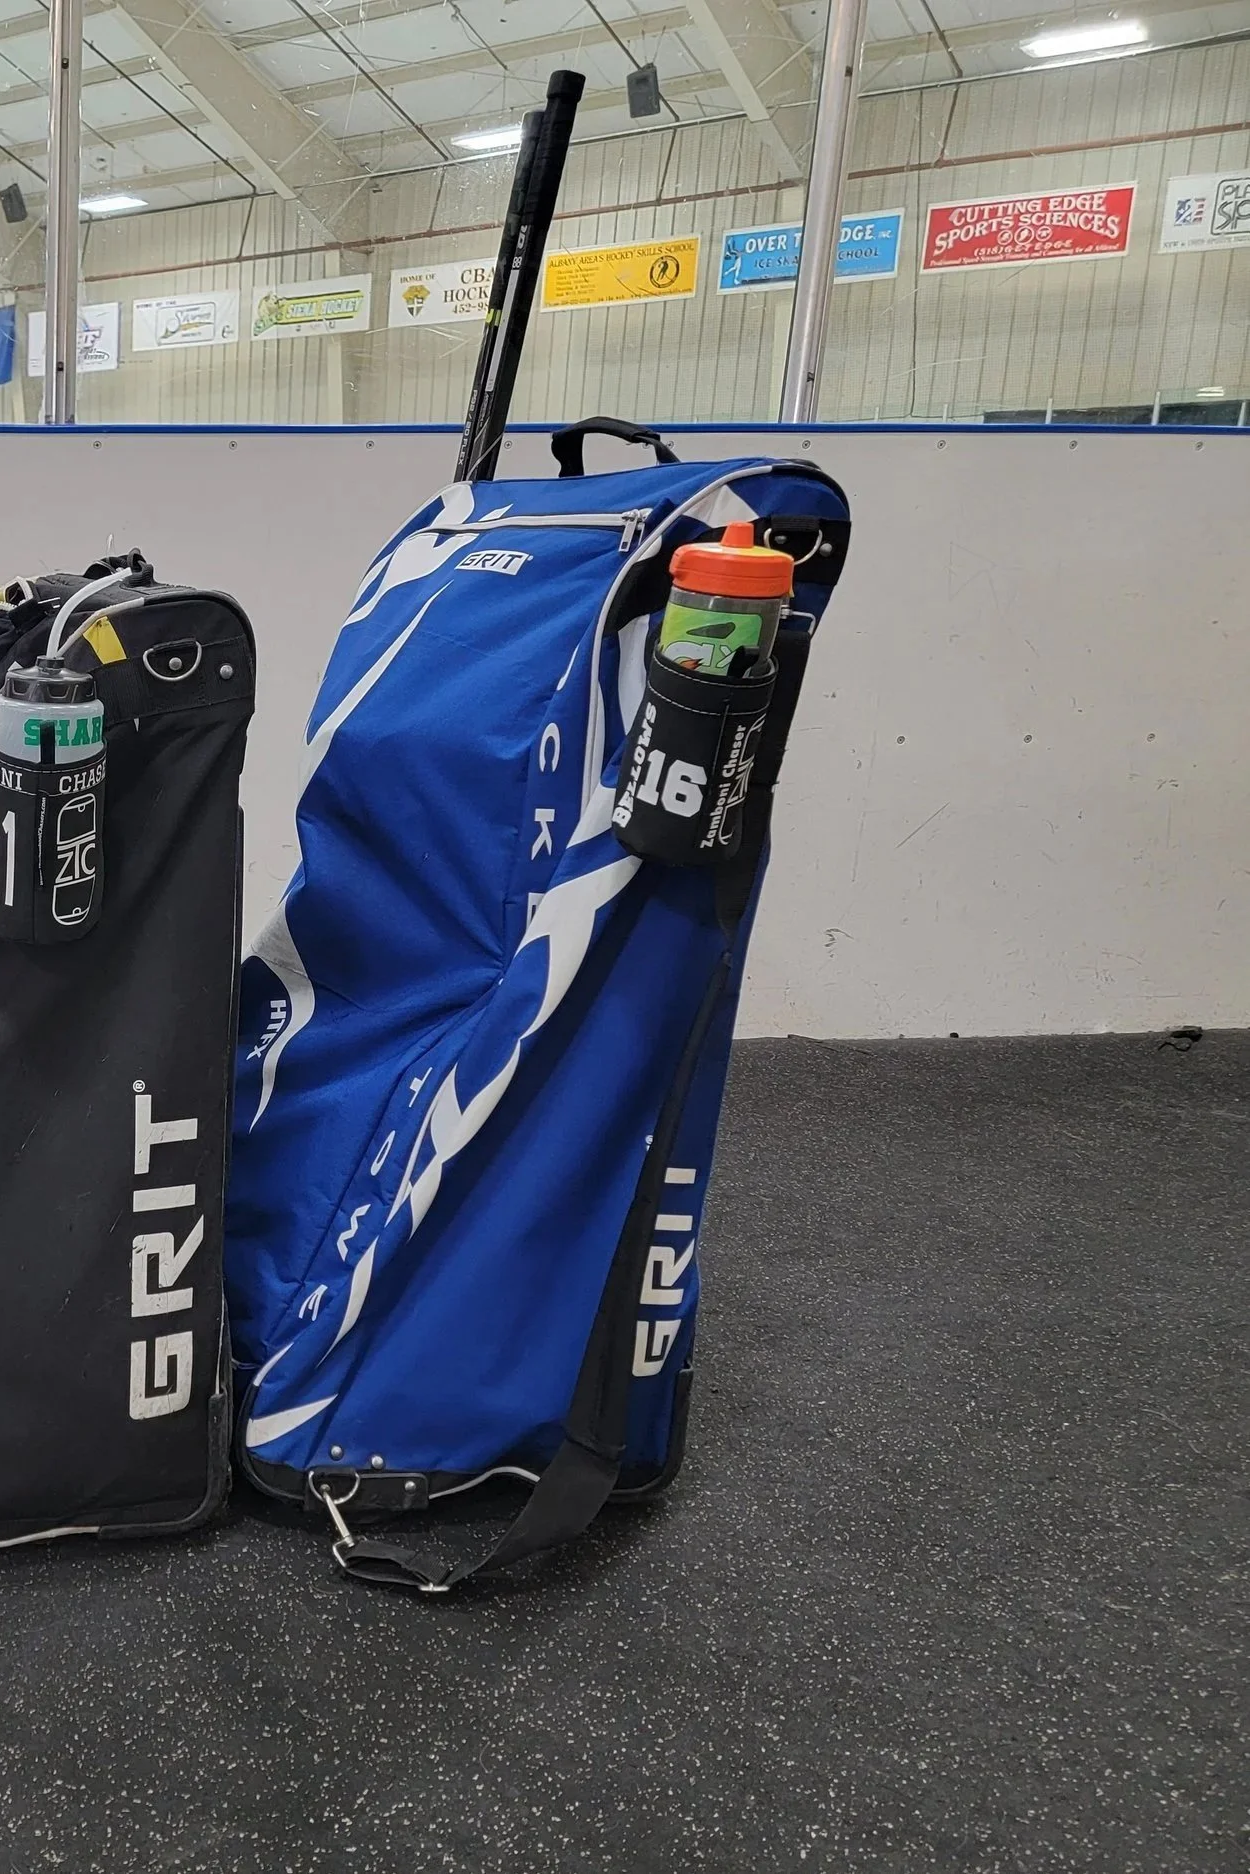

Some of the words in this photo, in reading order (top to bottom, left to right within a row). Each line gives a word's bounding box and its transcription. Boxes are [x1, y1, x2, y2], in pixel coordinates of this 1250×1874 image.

[950, 200, 1042, 227] CUTTING
[1048, 192, 1107, 212] EDGE
[745, 234, 787, 253] OVER
[933, 216, 1014, 256] SPORTS
[1019, 211, 1121, 239] SCIENCES
[550, 257, 576, 268] ALBANY
[606, 250, 634, 261] HOCKEY
[636, 246, 663, 257] SKILLS
[665, 243, 695, 254] SCHOOL
[754, 257, 771, 269] ICE
[776, 254, 800, 266] SKA
[838, 247, 879, 260] CHOOL
[400, 274, 424, 284] HOME
[426, 273, 437, 281] OF
[443, 286, 490, 303] HOCK
[458, 438, 468, 466] FLEX
[458, 552, 525, 571] GRIT
[612, 701, 657, 828] BELLOWS
[636, 749, 707, 817] 16
[700, 782, 731, 849] Zamboni
[722, 724, 747, 779] Chaser
[2, 810, 16, 907] 1
[55, 833, 96, 885] ZTC
[129, 1094, 204, 1421] GRIT
